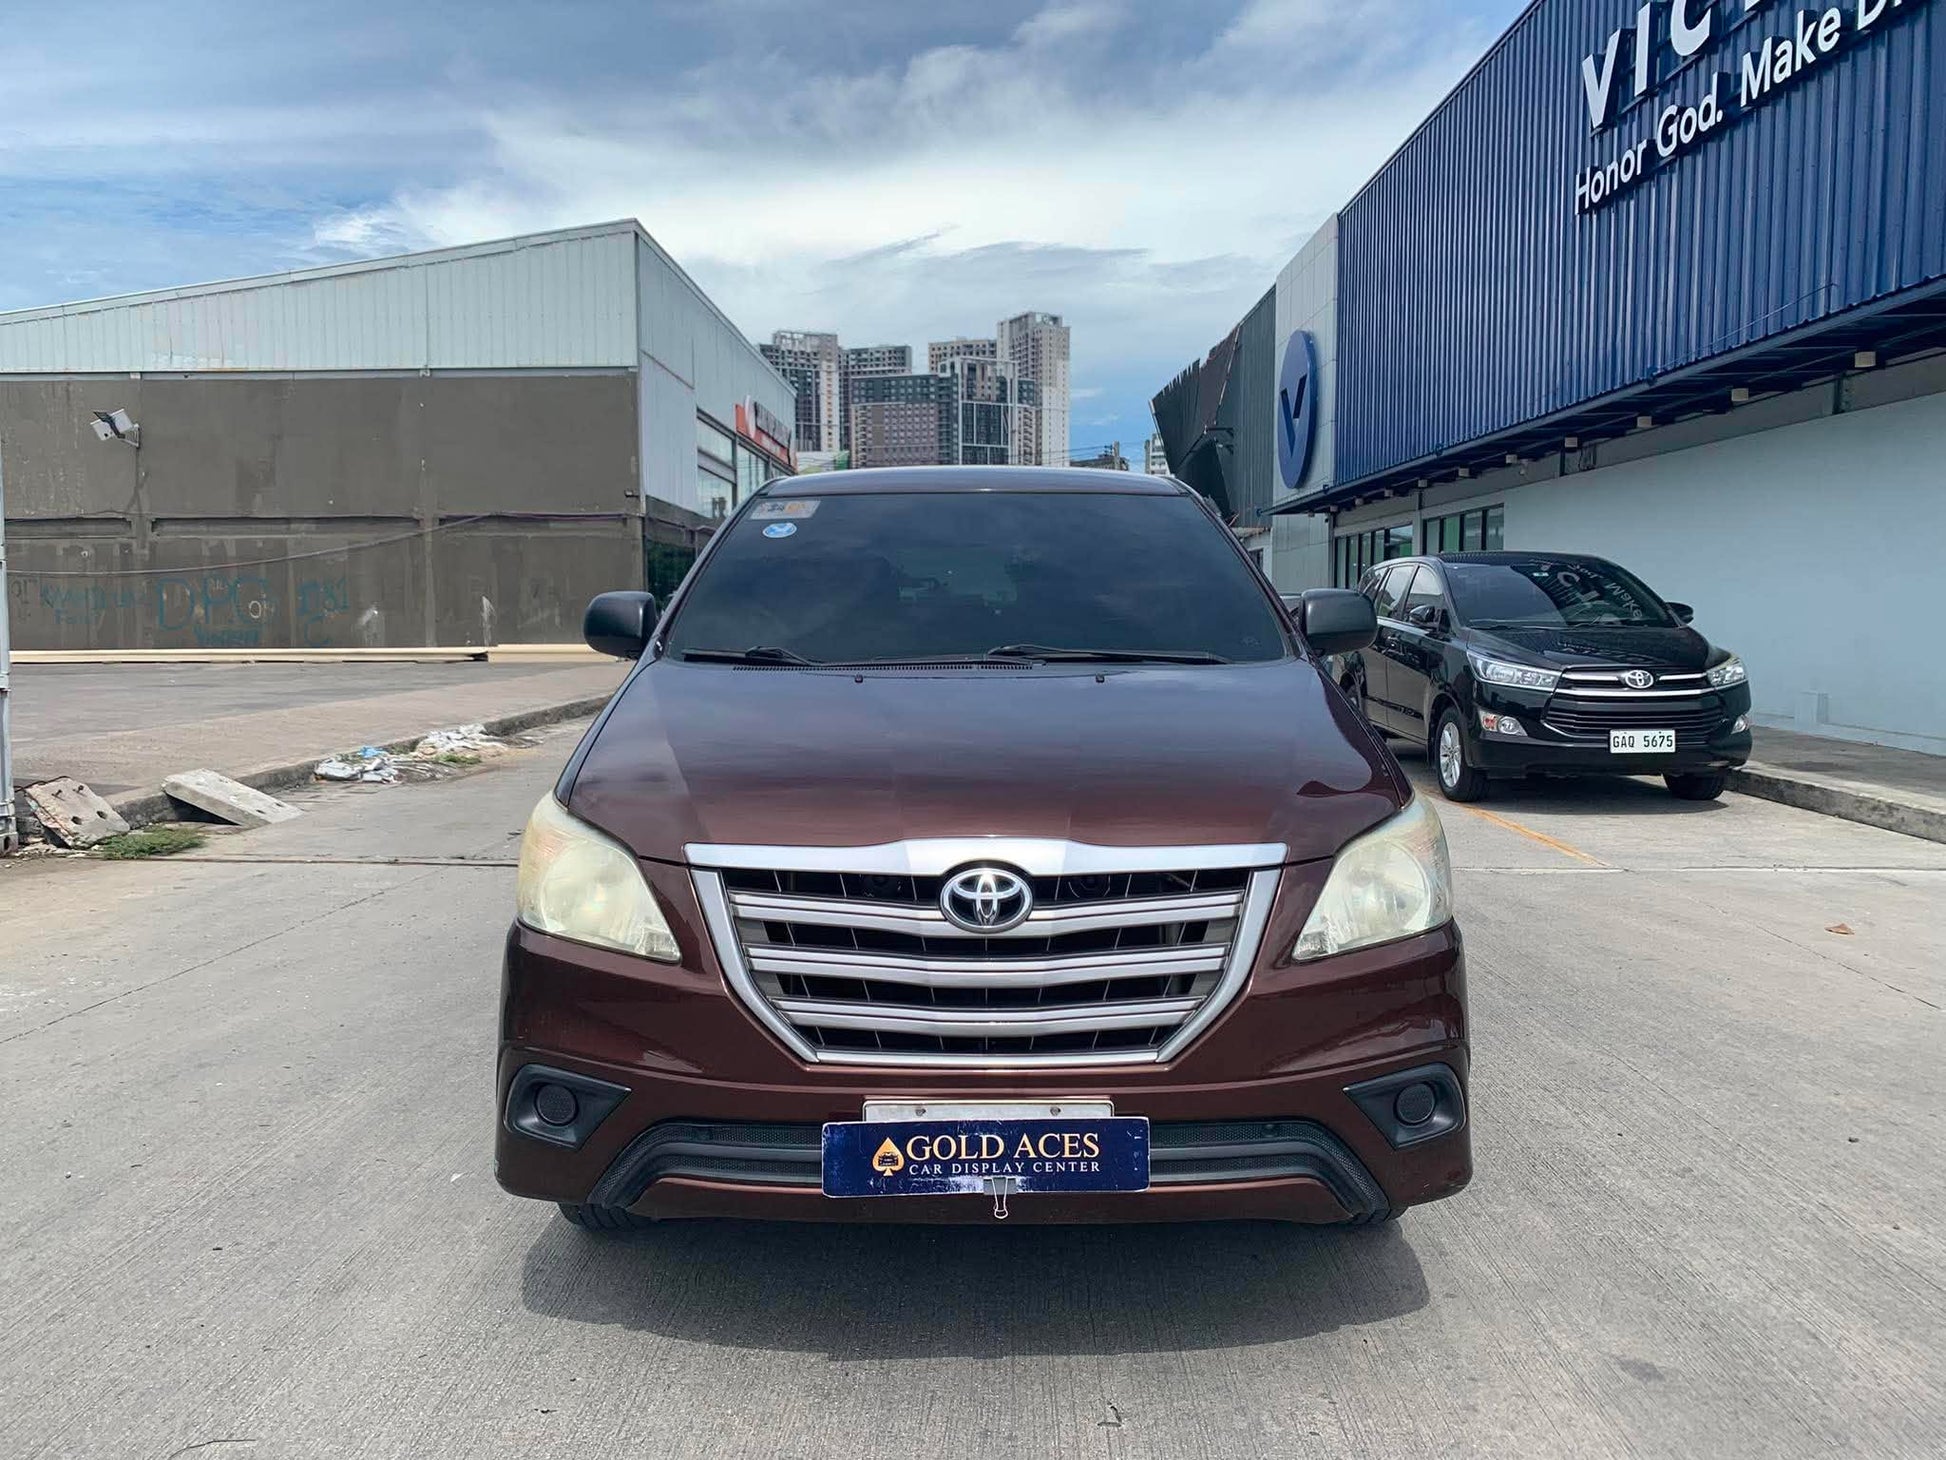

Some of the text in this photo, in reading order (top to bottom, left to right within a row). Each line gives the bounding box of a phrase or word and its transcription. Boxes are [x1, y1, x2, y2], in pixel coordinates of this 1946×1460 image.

[1582, 0, 1760, 129] VIC
[1574, 138, 1648, 215] Honor
[1656, 71, 1723, 157] God.
[1740, 7, 1841, 107] Make
[1612, 734, 1673, 748] GAQ 5675
[905, 1132, 1101, 1161] GOLD ACES
[908, 1160, 1101, 1175] CAR DISPLAY CENTER
